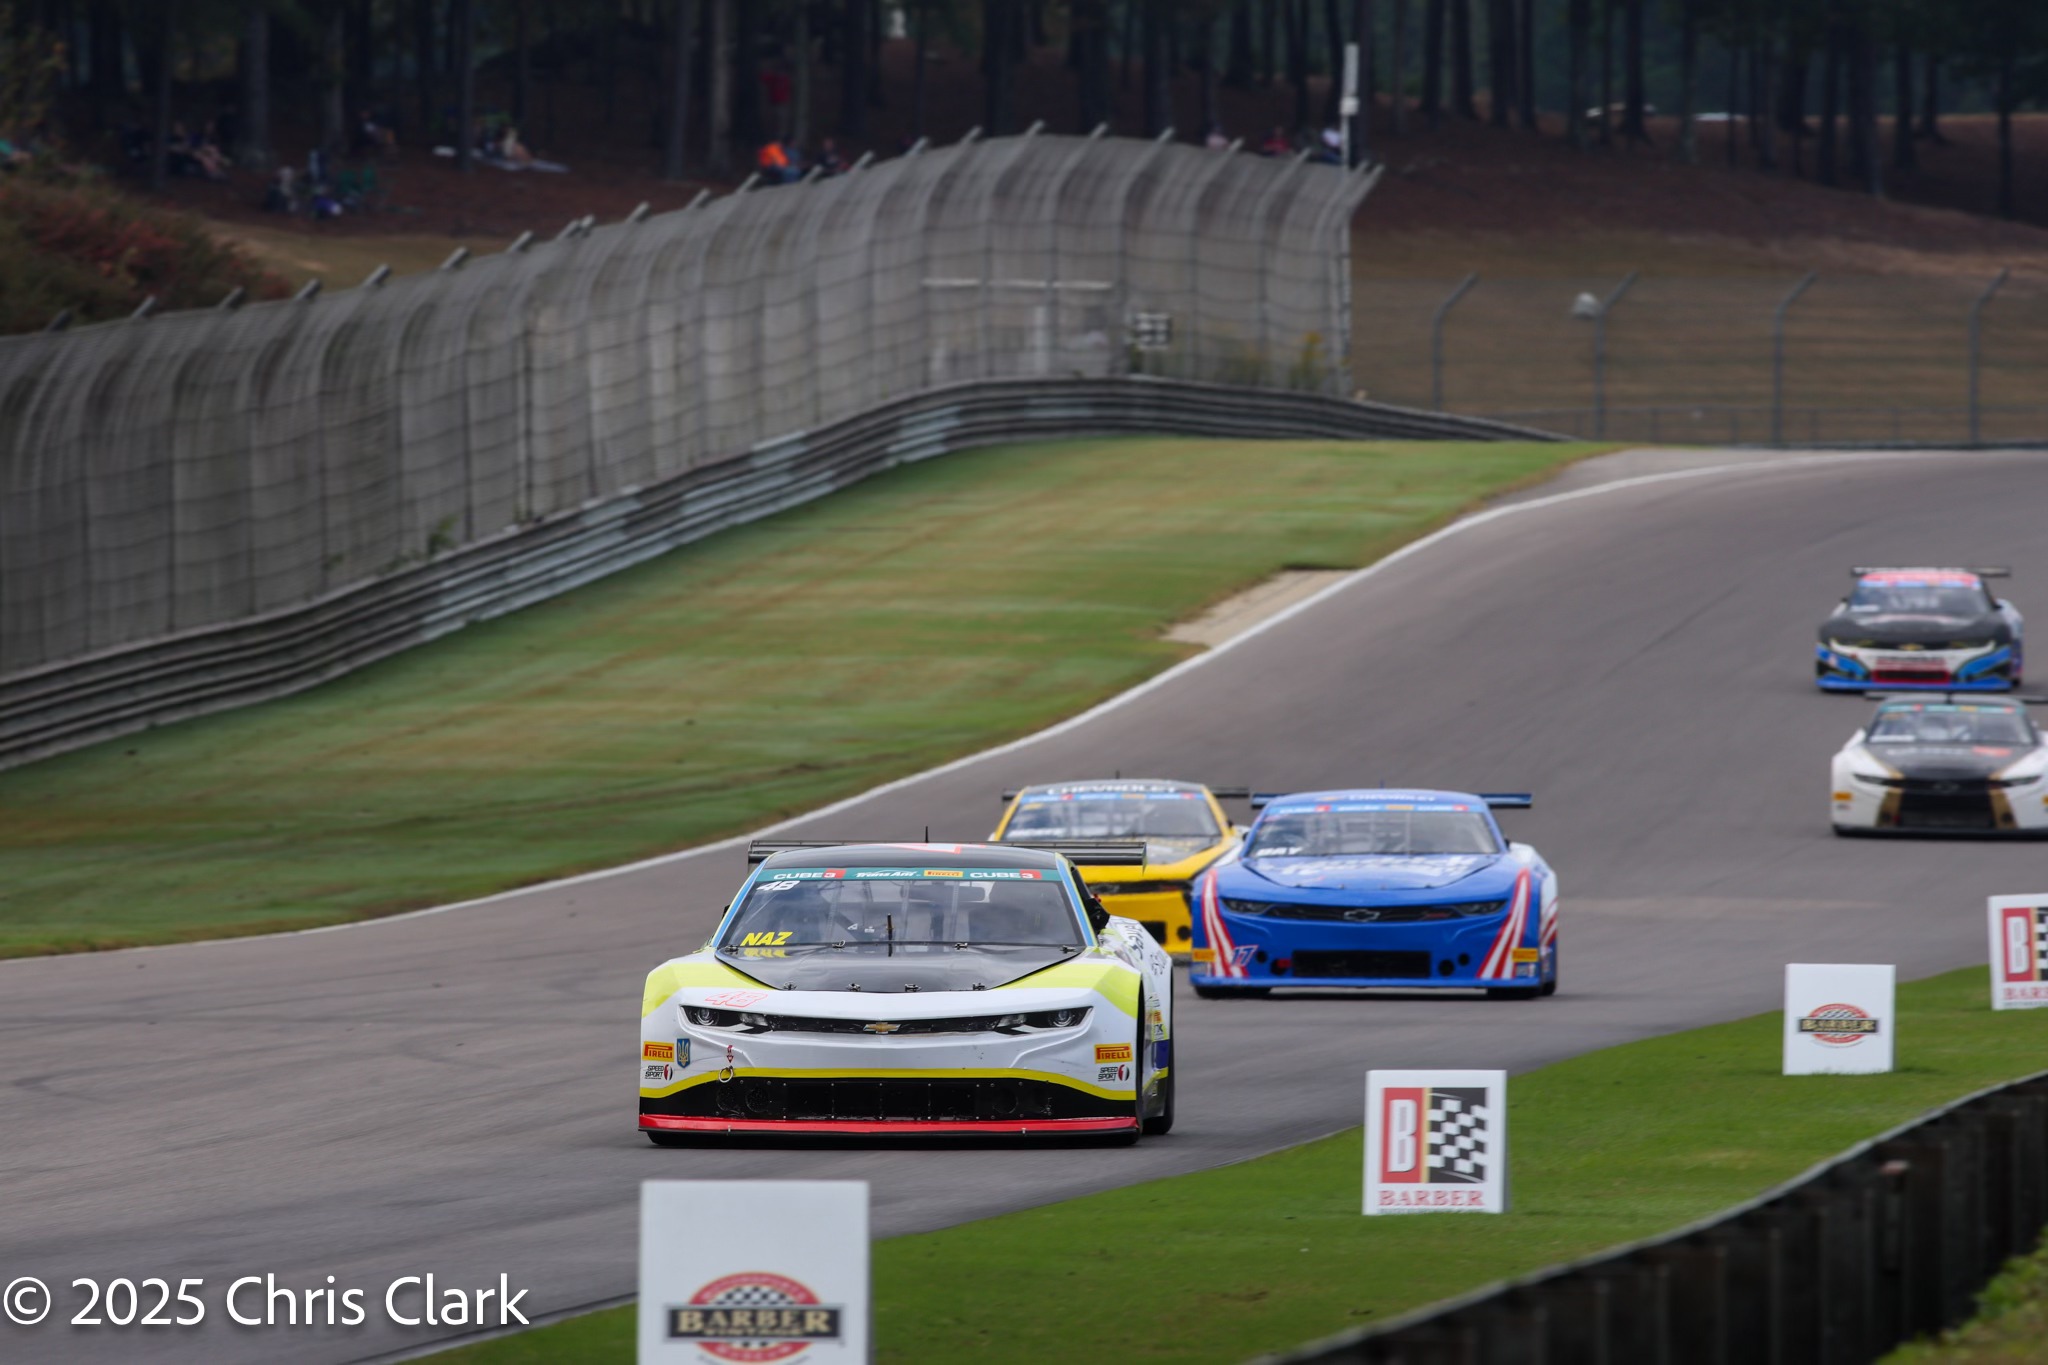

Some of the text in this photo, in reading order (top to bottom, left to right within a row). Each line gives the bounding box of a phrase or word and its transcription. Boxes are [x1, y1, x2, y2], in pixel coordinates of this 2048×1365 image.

[773, 868, 837, 880] CUBE3
[969, 871, 1035, 879] CUBE3
[756, 880, 800, 891] 48
[739, 931, 793, 947] NAZ
[2006, 916, 2029, 973] B
[1231, 945, 1259, 966] 17
[704, 991, 769, 1008] 48
[1802, 1020, 1875, 1030] BARBER
[644, 1043, 673, 1059] PIRELLI
[1096, 1046, 1130, 1060] PIRELLI
[1387, 1099, 1417, 1172] B
[1378, 1190, 1485, 1206] BARBER
[677, 1310, 832, 1334] BARBER
